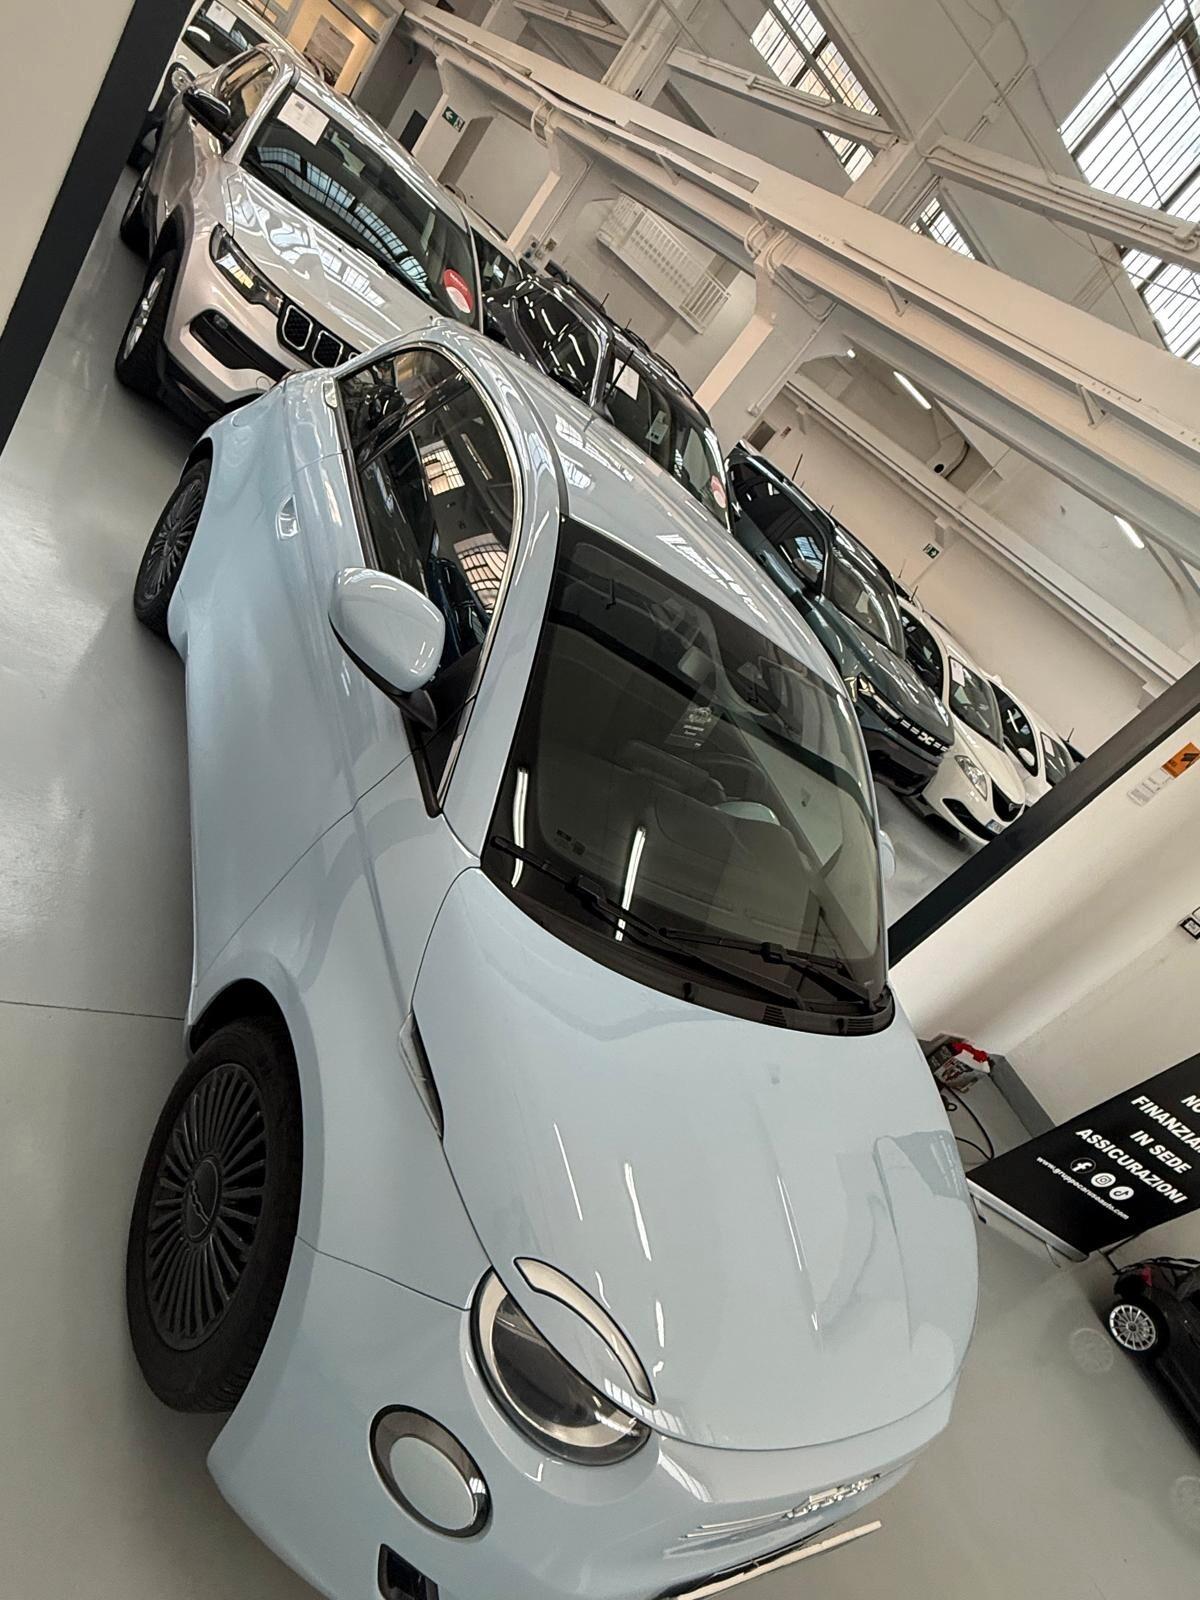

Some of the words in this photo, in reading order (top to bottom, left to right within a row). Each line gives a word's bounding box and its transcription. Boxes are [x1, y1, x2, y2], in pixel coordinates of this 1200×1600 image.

[1129, 1095, 1200, 1153] FINANZIA
[1129, 1130, 1155, 1147] IN
[1149, 1144, 1192, 1174] SEDE
[1075, 1128, 1188, 1204] ASSICURAZIONI
